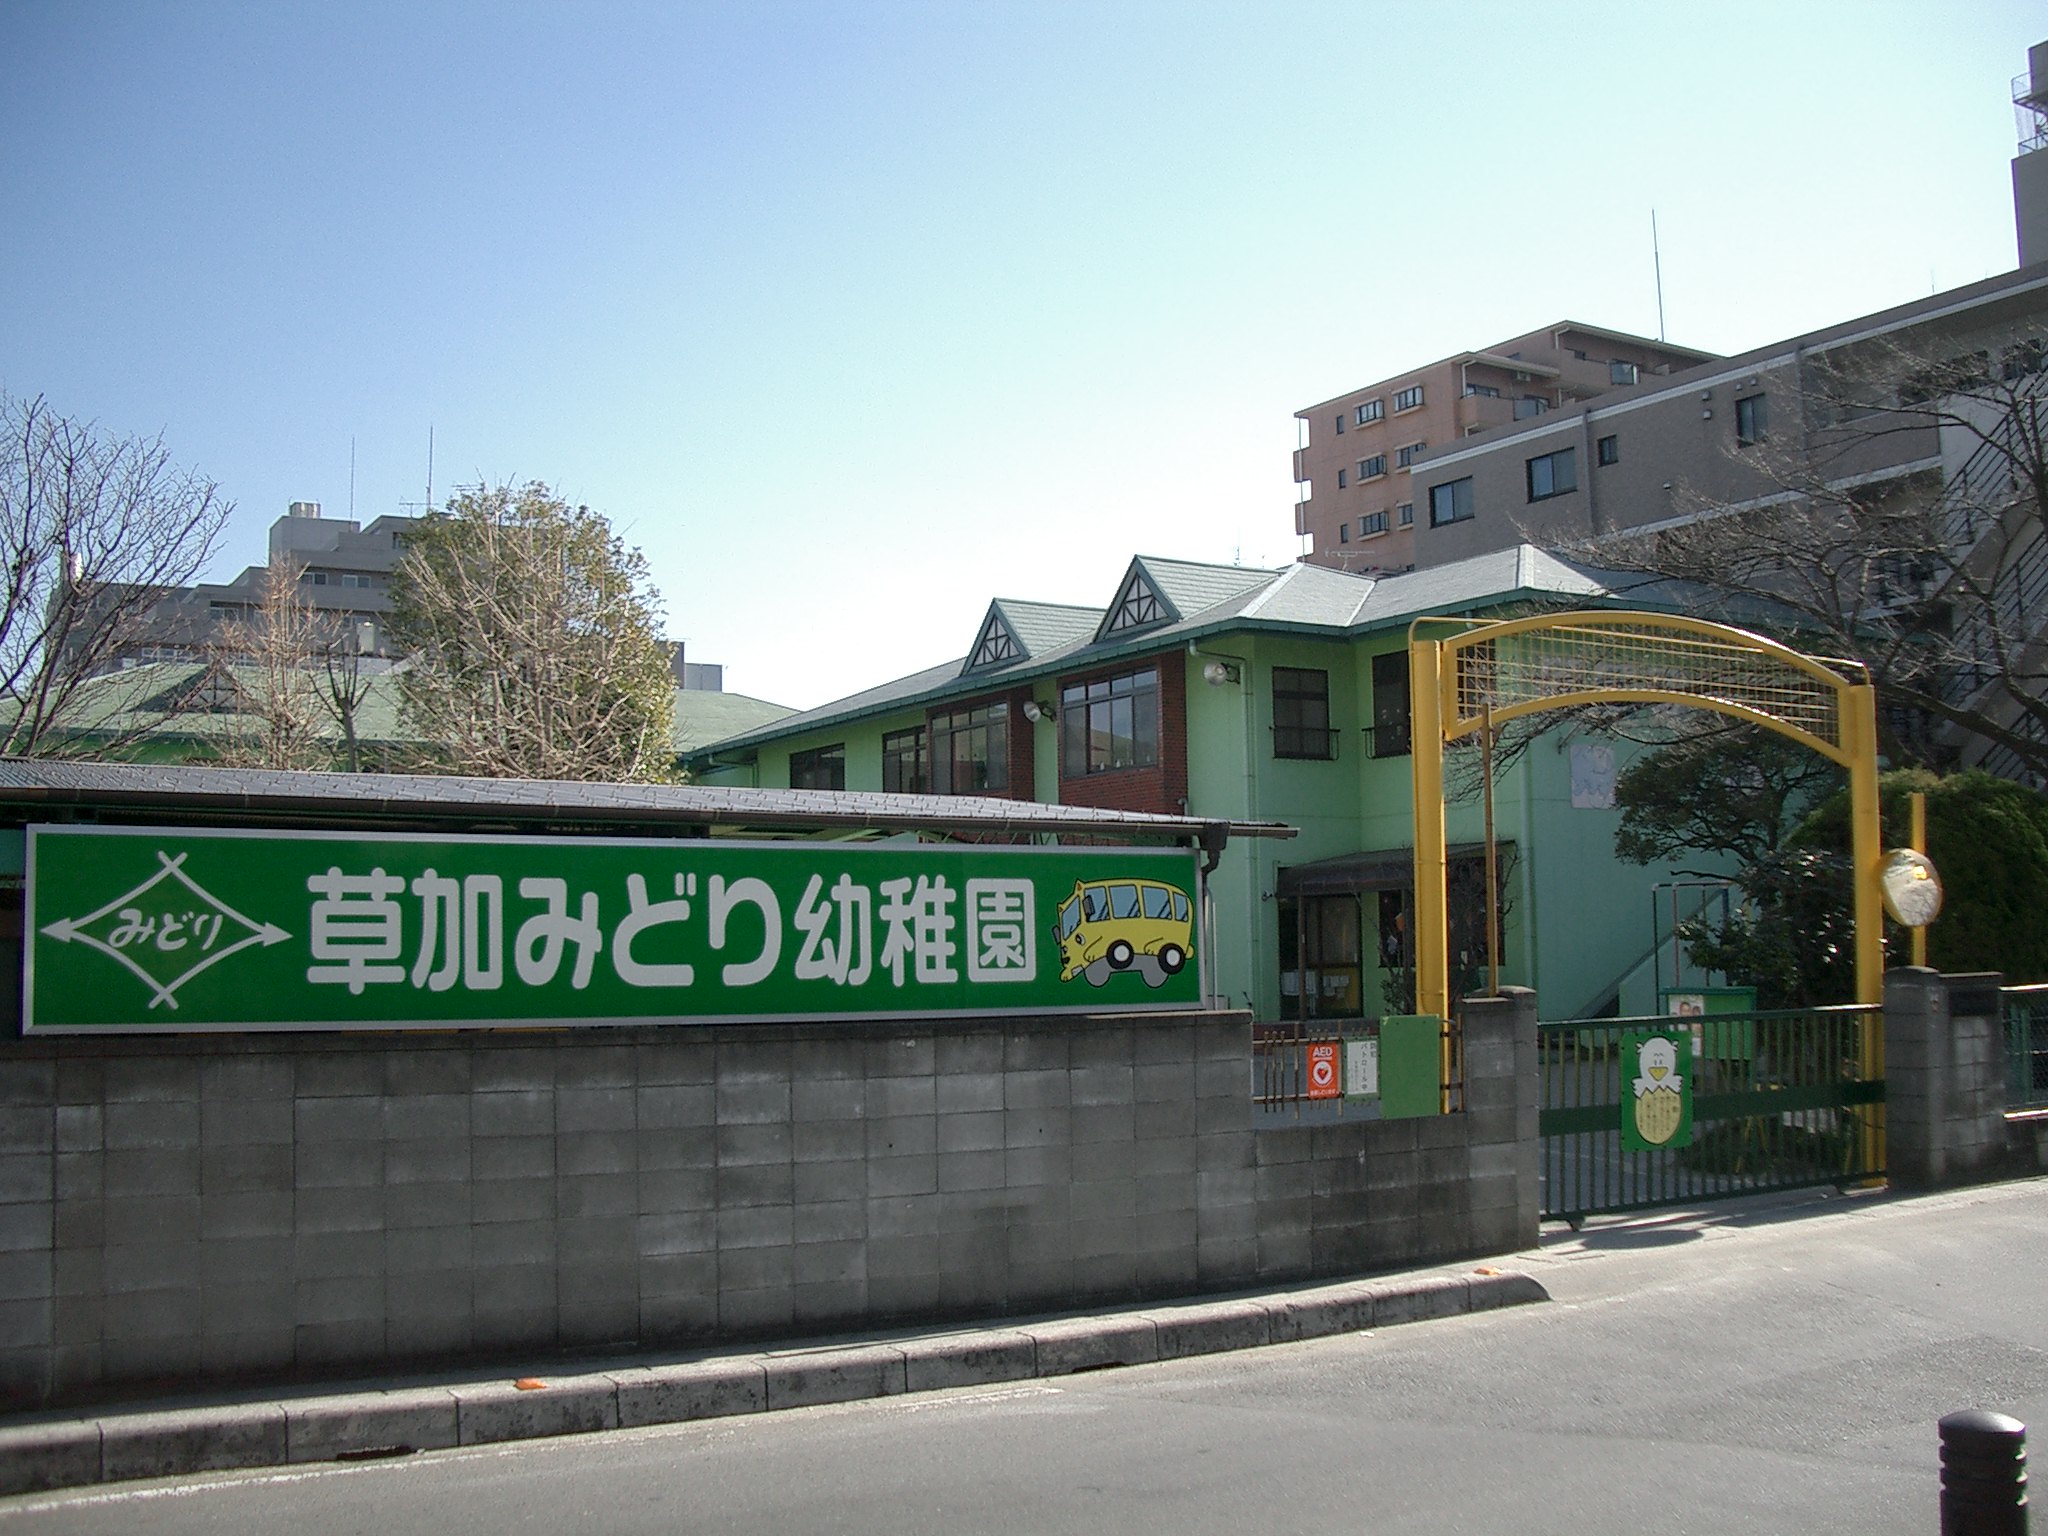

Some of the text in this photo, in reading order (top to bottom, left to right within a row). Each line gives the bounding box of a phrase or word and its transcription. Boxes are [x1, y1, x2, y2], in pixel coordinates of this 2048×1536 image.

[107, 906, 225, 952] みどり
[307, 866, 1037, 995] 草加みどり幼稚園
[1312, 1046, 1333, 1057] AED
